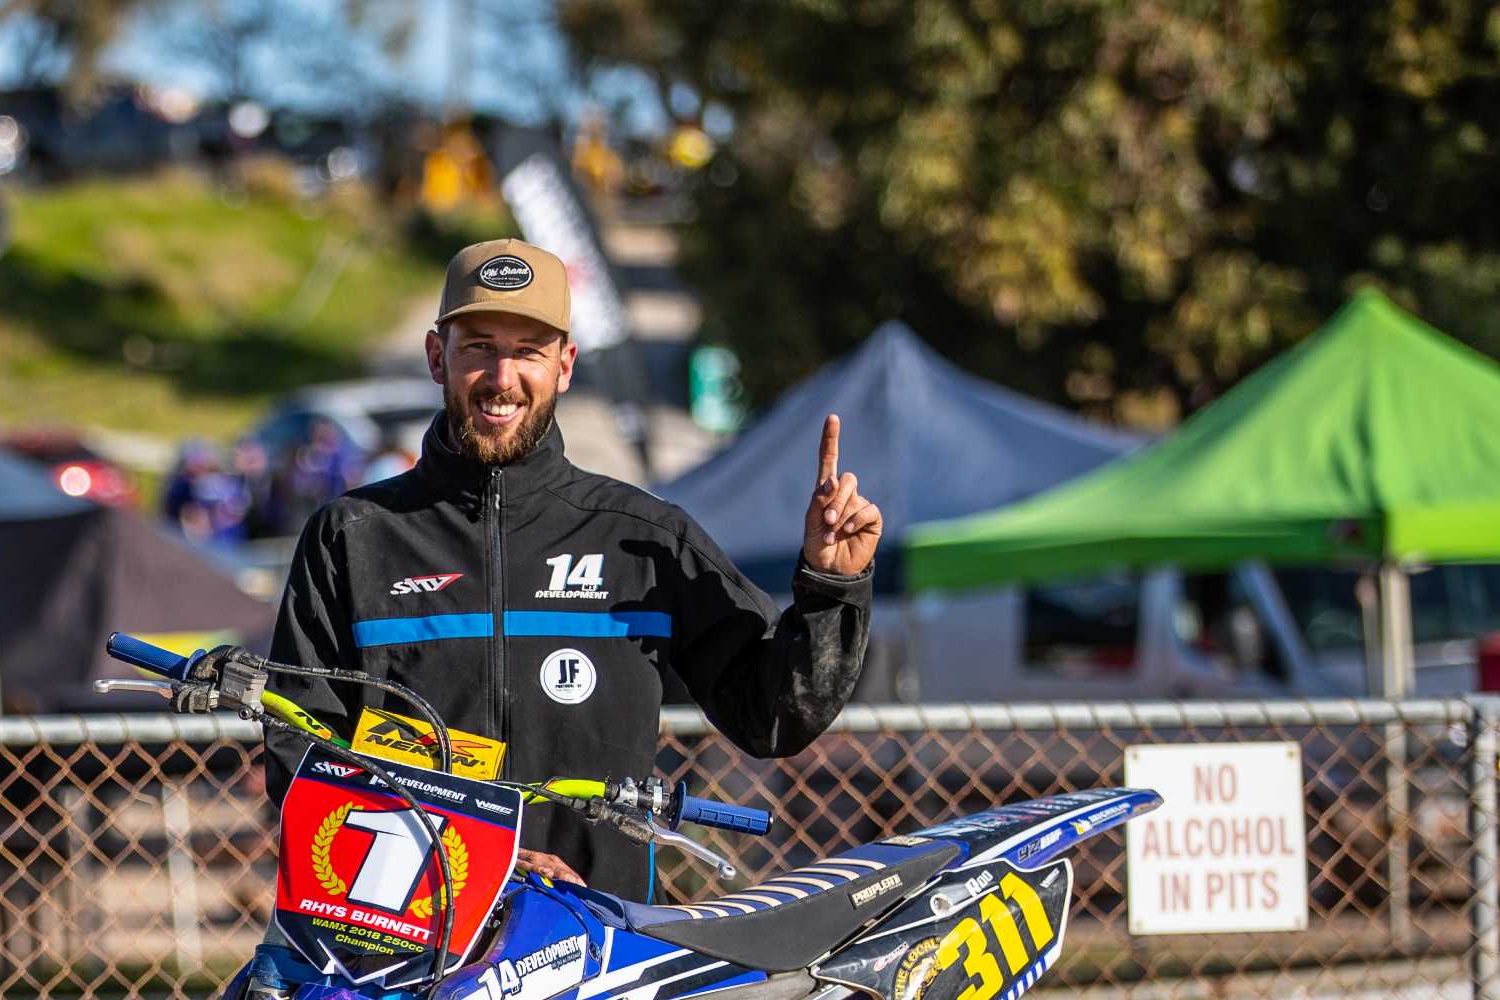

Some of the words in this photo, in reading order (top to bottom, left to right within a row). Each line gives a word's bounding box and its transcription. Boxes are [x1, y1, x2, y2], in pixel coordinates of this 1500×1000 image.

[500, 266, 528, 277] Brand
[545, 553, 605, 591] 14
[534, 590, 610, 600] DEVELOPMENT
[558, 659, 580, 684] JF
[364, 733, 479, 768] NEKN
[395, 775, 467, 802] DEVELOPMENT
[1192, 763, 1238, 804] NO
[1141, 817, 1296, 860] ALCOHOL
[344, 807, 448, 916] 1
[1158, 870, 1193, 913] IN
[1204, 868, 1281, 913] PITS
[299, 899, 347, 918] RHYS
[350, 909, 435, 942] BURNETT
[311, 917, 348, 934] WAMX
[349, 926, 383, 941] 2018
[384, 934, 425, 953] 250cc
[335, 934, 395, 956] Champion
[516, 936, 580, 977] DEVELOPMENT
[904, 937, 940, 970] LOCAL
